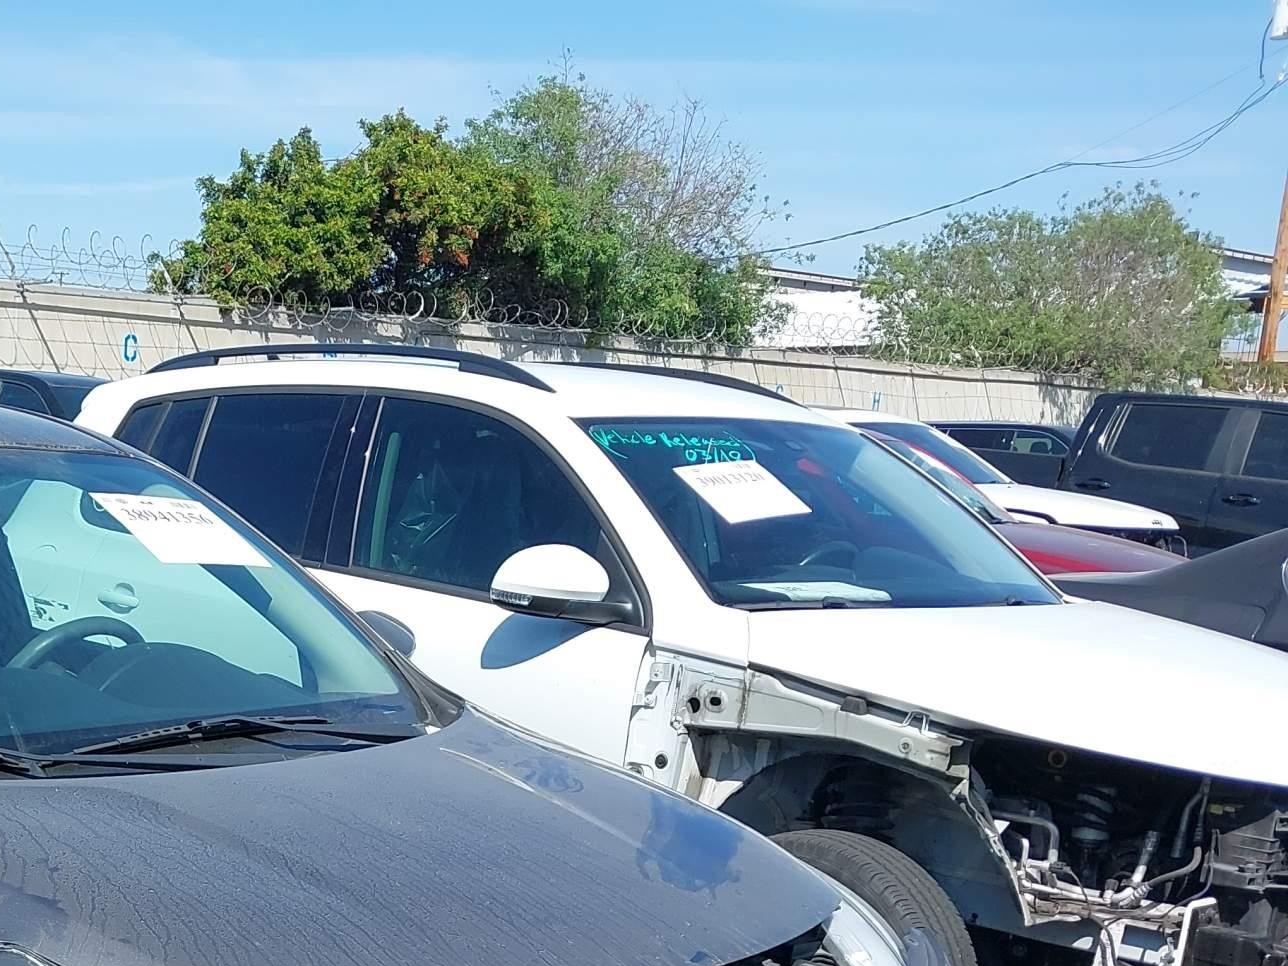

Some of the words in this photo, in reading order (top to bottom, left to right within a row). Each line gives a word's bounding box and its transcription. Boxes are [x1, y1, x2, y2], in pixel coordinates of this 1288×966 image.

[123, 334, 137, 362] C
[872, 391, 882, 412] H
[593, 428, 657, 447] Vehicle
[120, 507, 214, 525] 38941356
